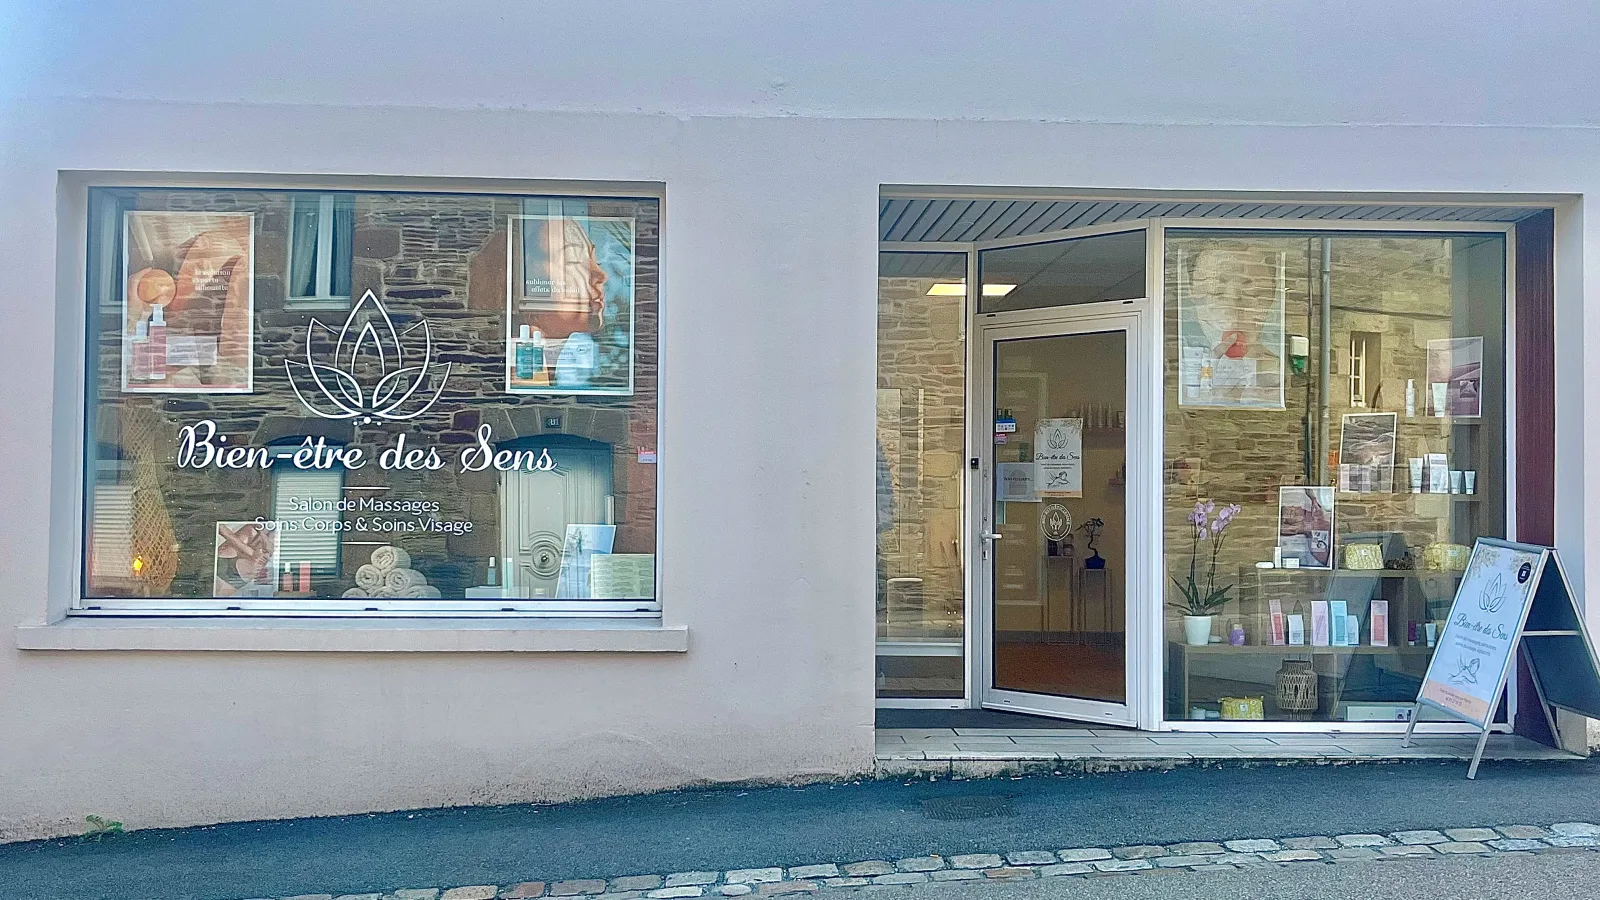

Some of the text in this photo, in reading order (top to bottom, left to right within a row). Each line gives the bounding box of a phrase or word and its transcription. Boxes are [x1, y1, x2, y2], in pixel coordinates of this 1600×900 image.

[177, 419, 558, 474] Bien-être des Sens
[289, 496, 440, 515] Salon de Massages
[254, 516, 473, 536] Soins Corps & Soins Visage
